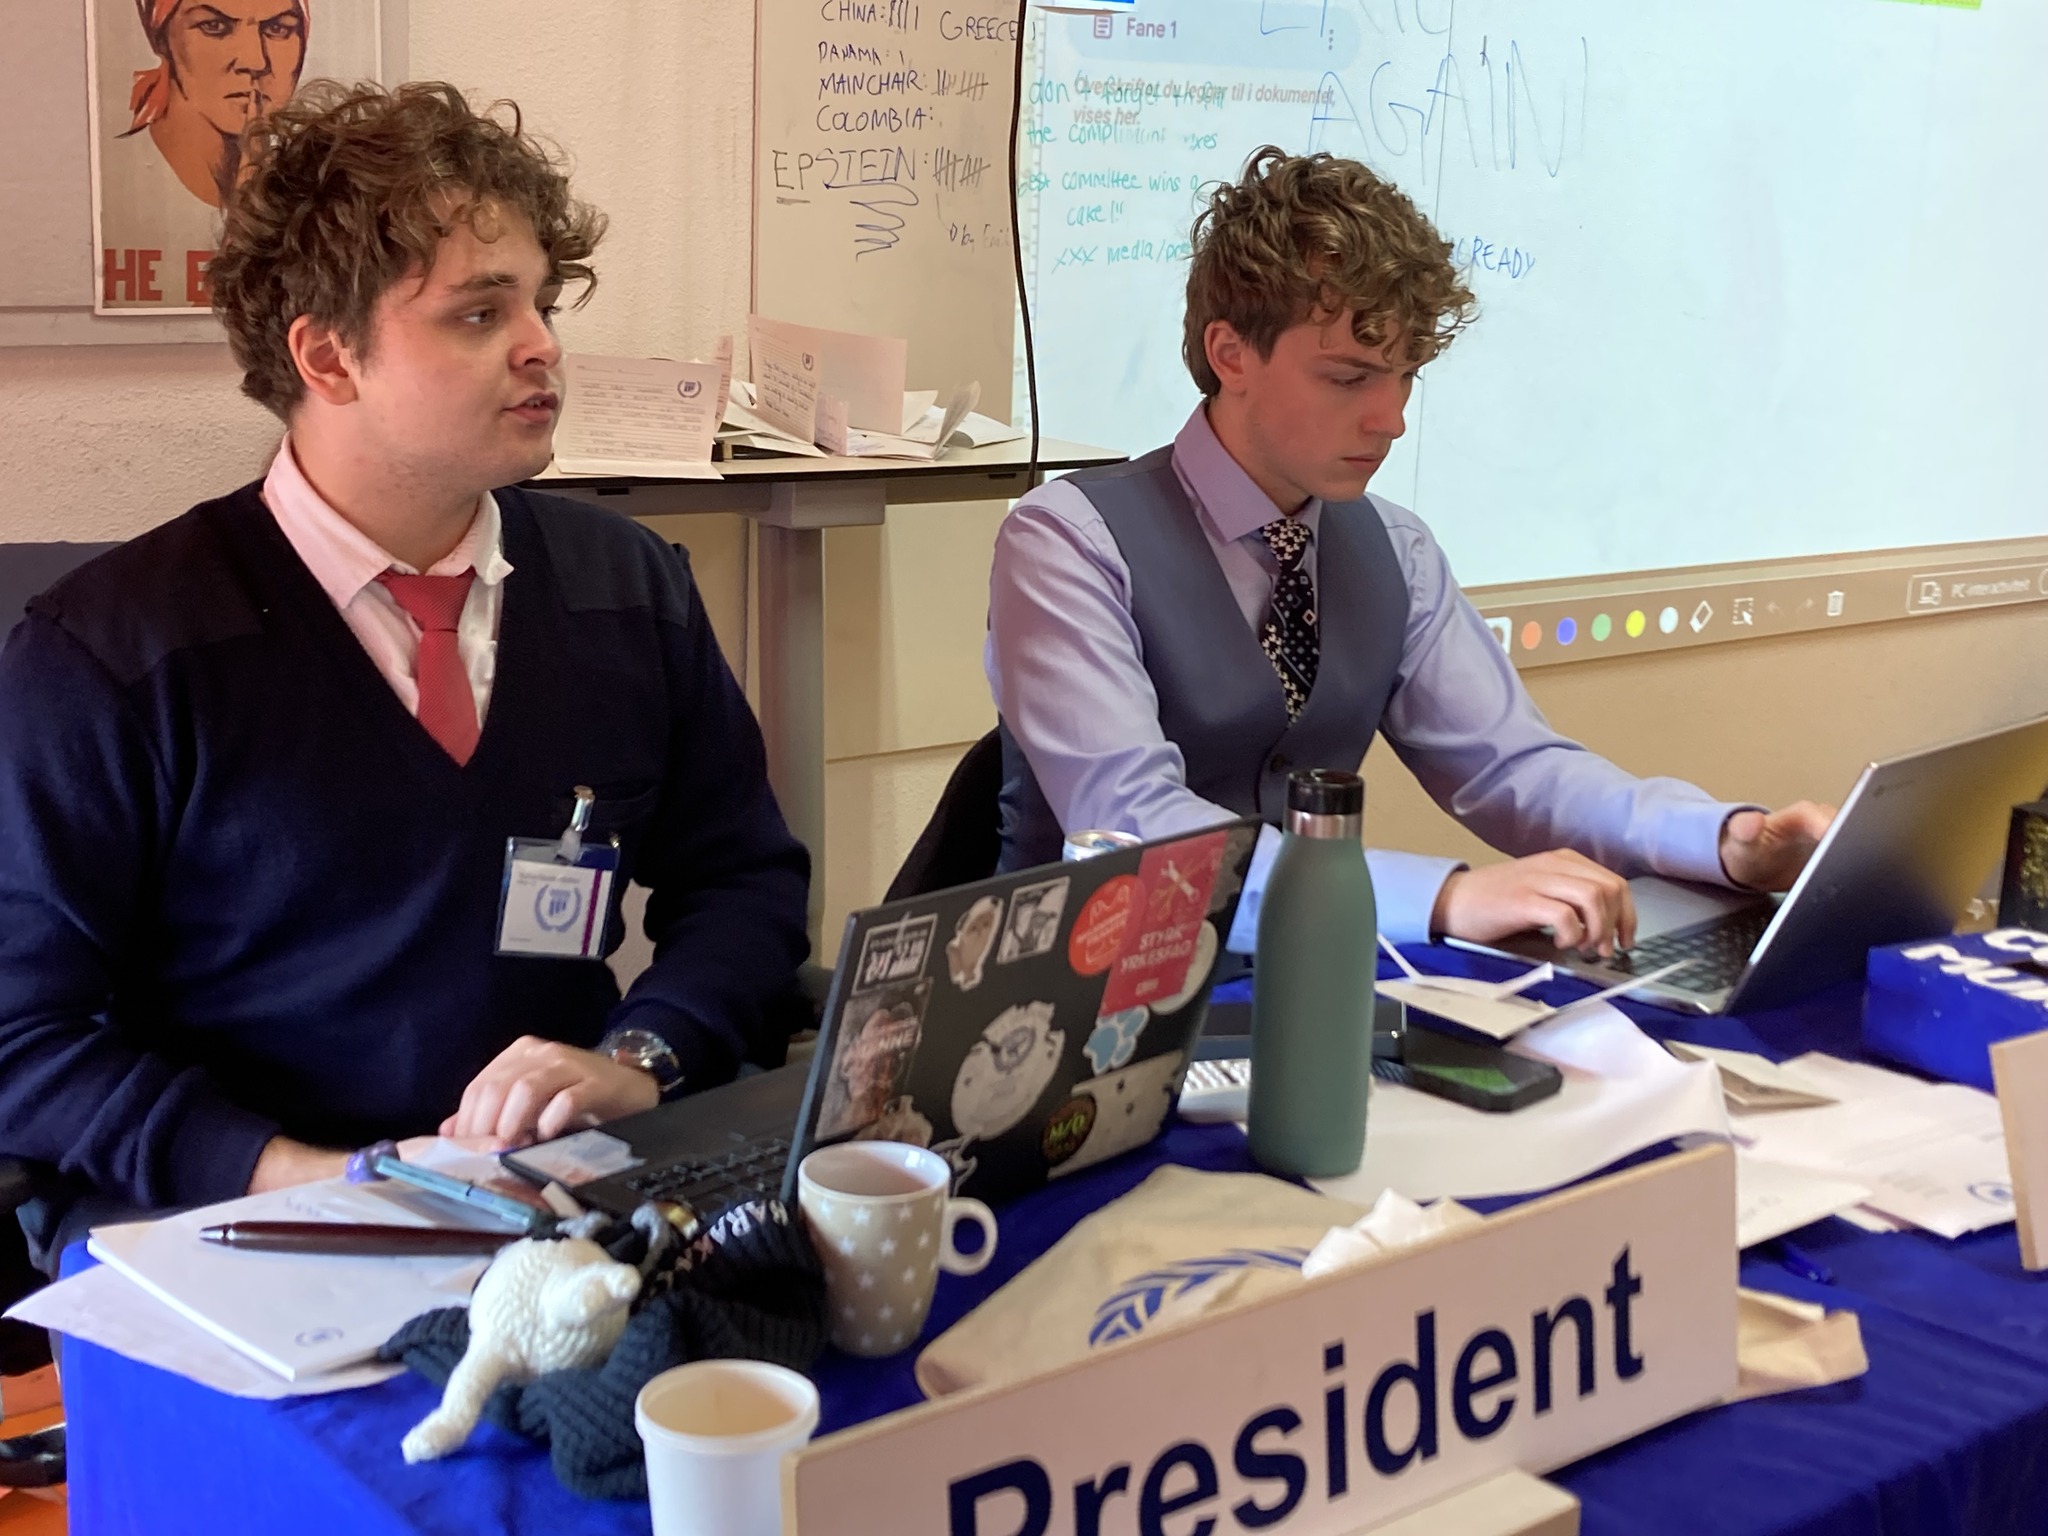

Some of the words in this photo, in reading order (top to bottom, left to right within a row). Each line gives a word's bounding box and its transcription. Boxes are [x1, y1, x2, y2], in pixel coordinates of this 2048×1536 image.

[1126, 18, 1166, 38] Fane
[1170, 21, 1178, 39] 1
[1231, 82, 1246, 101] til
[1247, 83, 1254, 102] i
[1073, 105, 1112, 125] vises
[1026, 122, 1057, 144] the
[1149, 170, 1181, 191] wins
